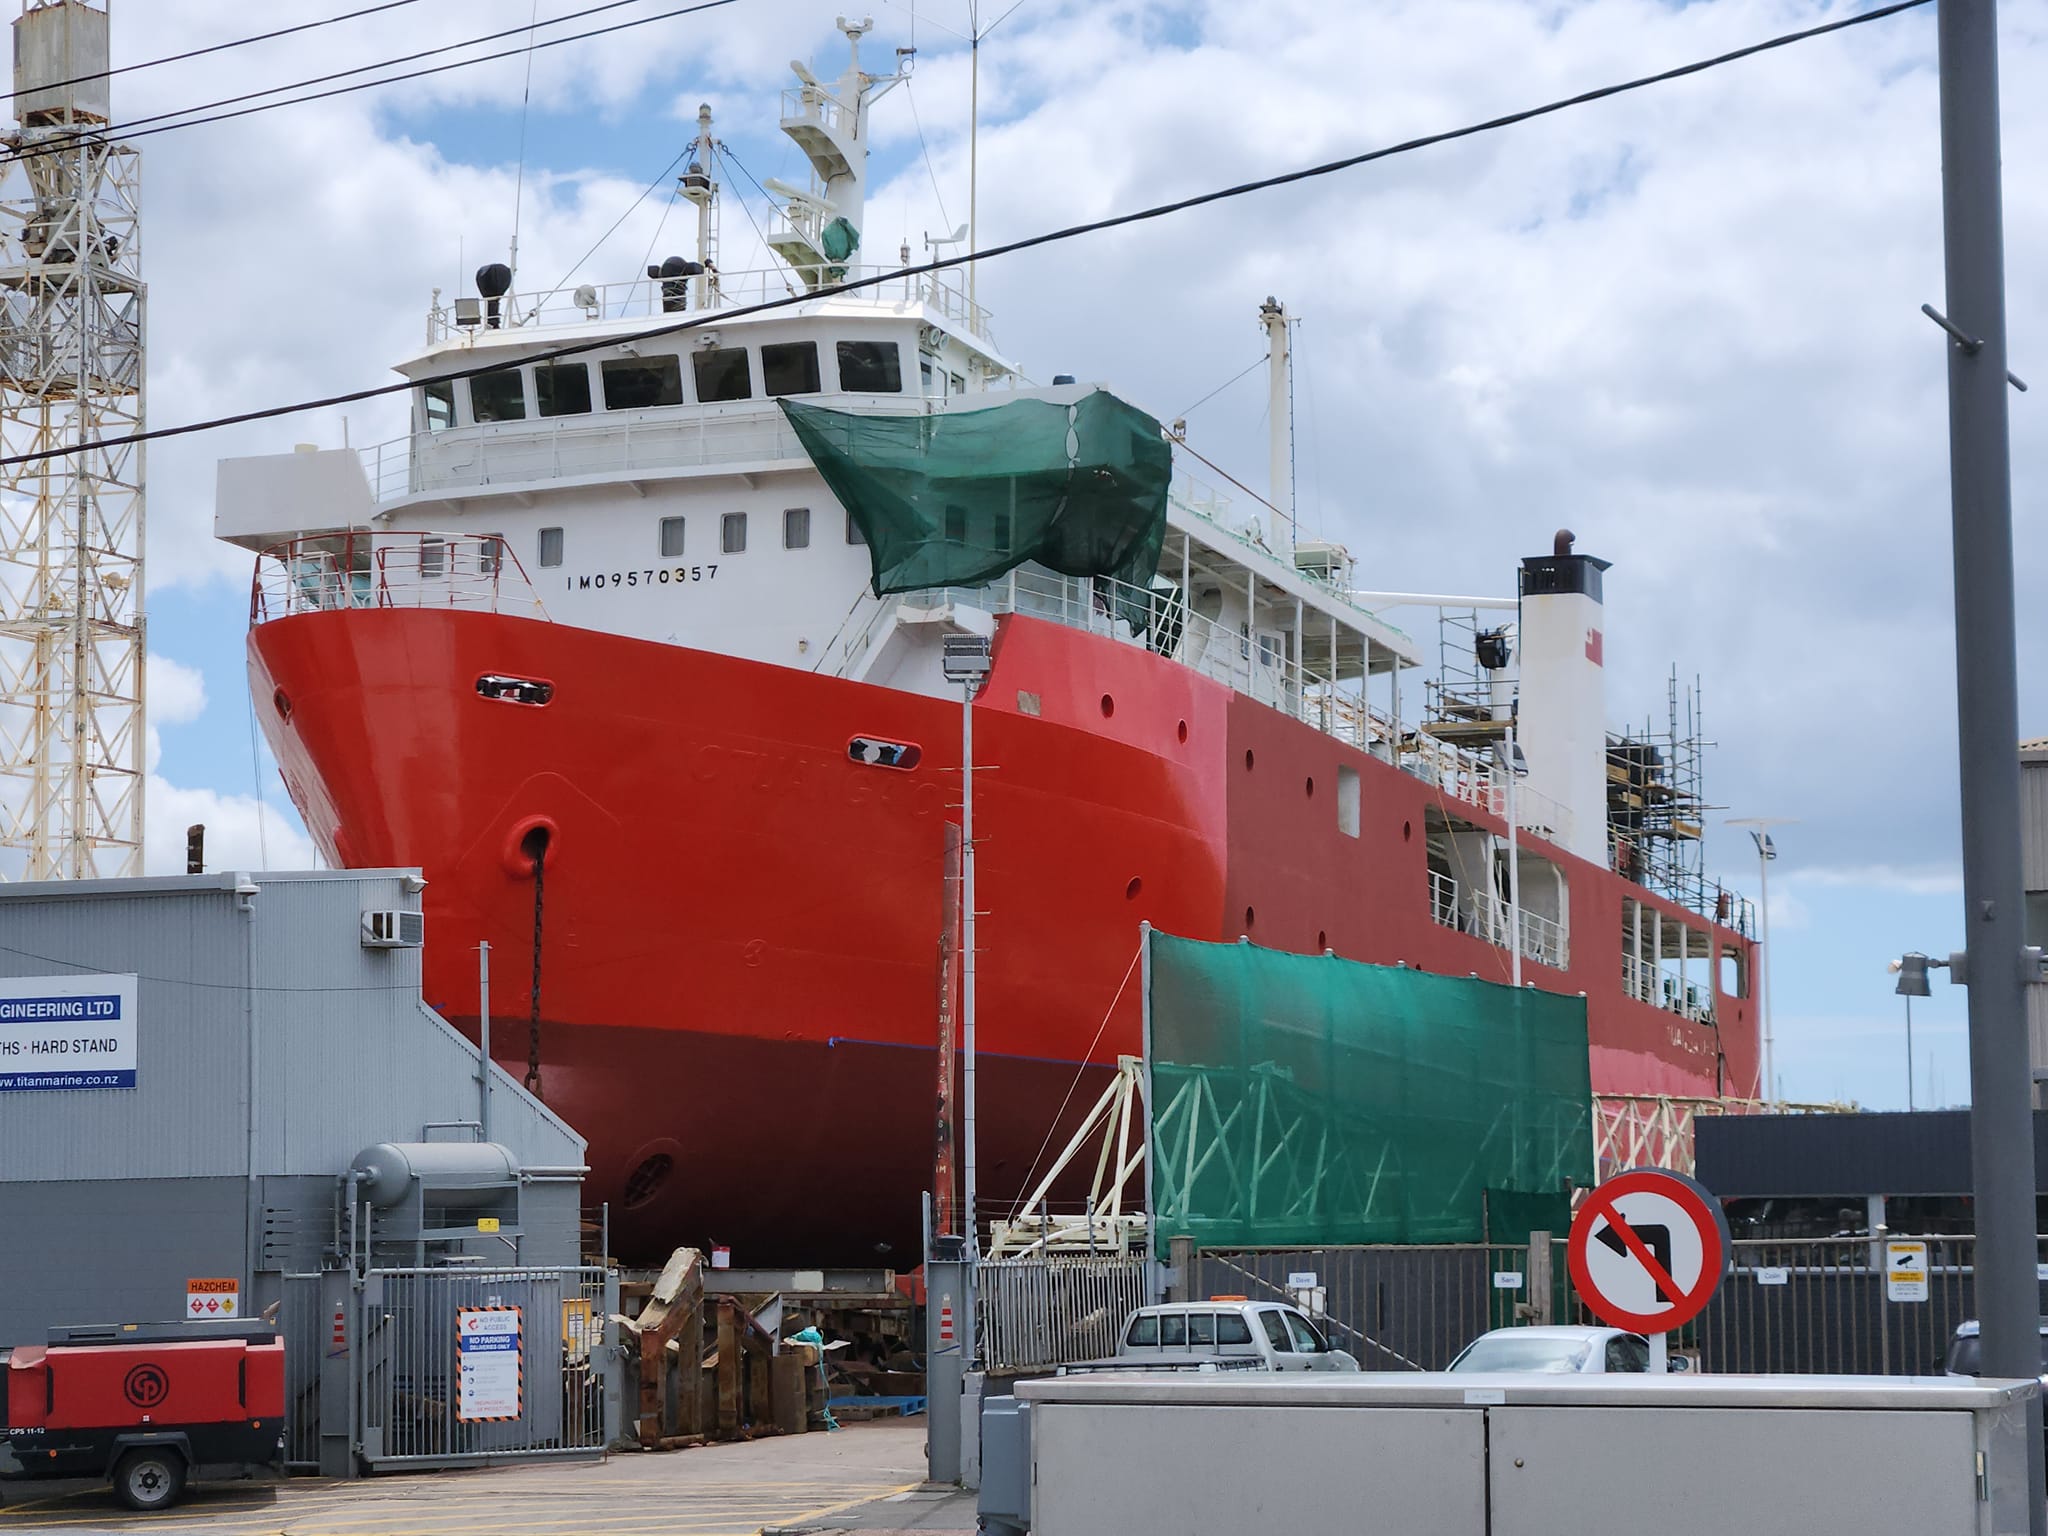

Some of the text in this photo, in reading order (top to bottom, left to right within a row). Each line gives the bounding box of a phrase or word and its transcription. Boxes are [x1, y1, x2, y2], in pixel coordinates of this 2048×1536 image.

[87, 1001, 114, 1015] LTD
[31, 1040, 69, 1054] HARD
[72, 1039, 118, 1053] STAND
[191, 1282, 235, 1292] HAZCHEM
[481, 1336, 510, 1344] PARKING
